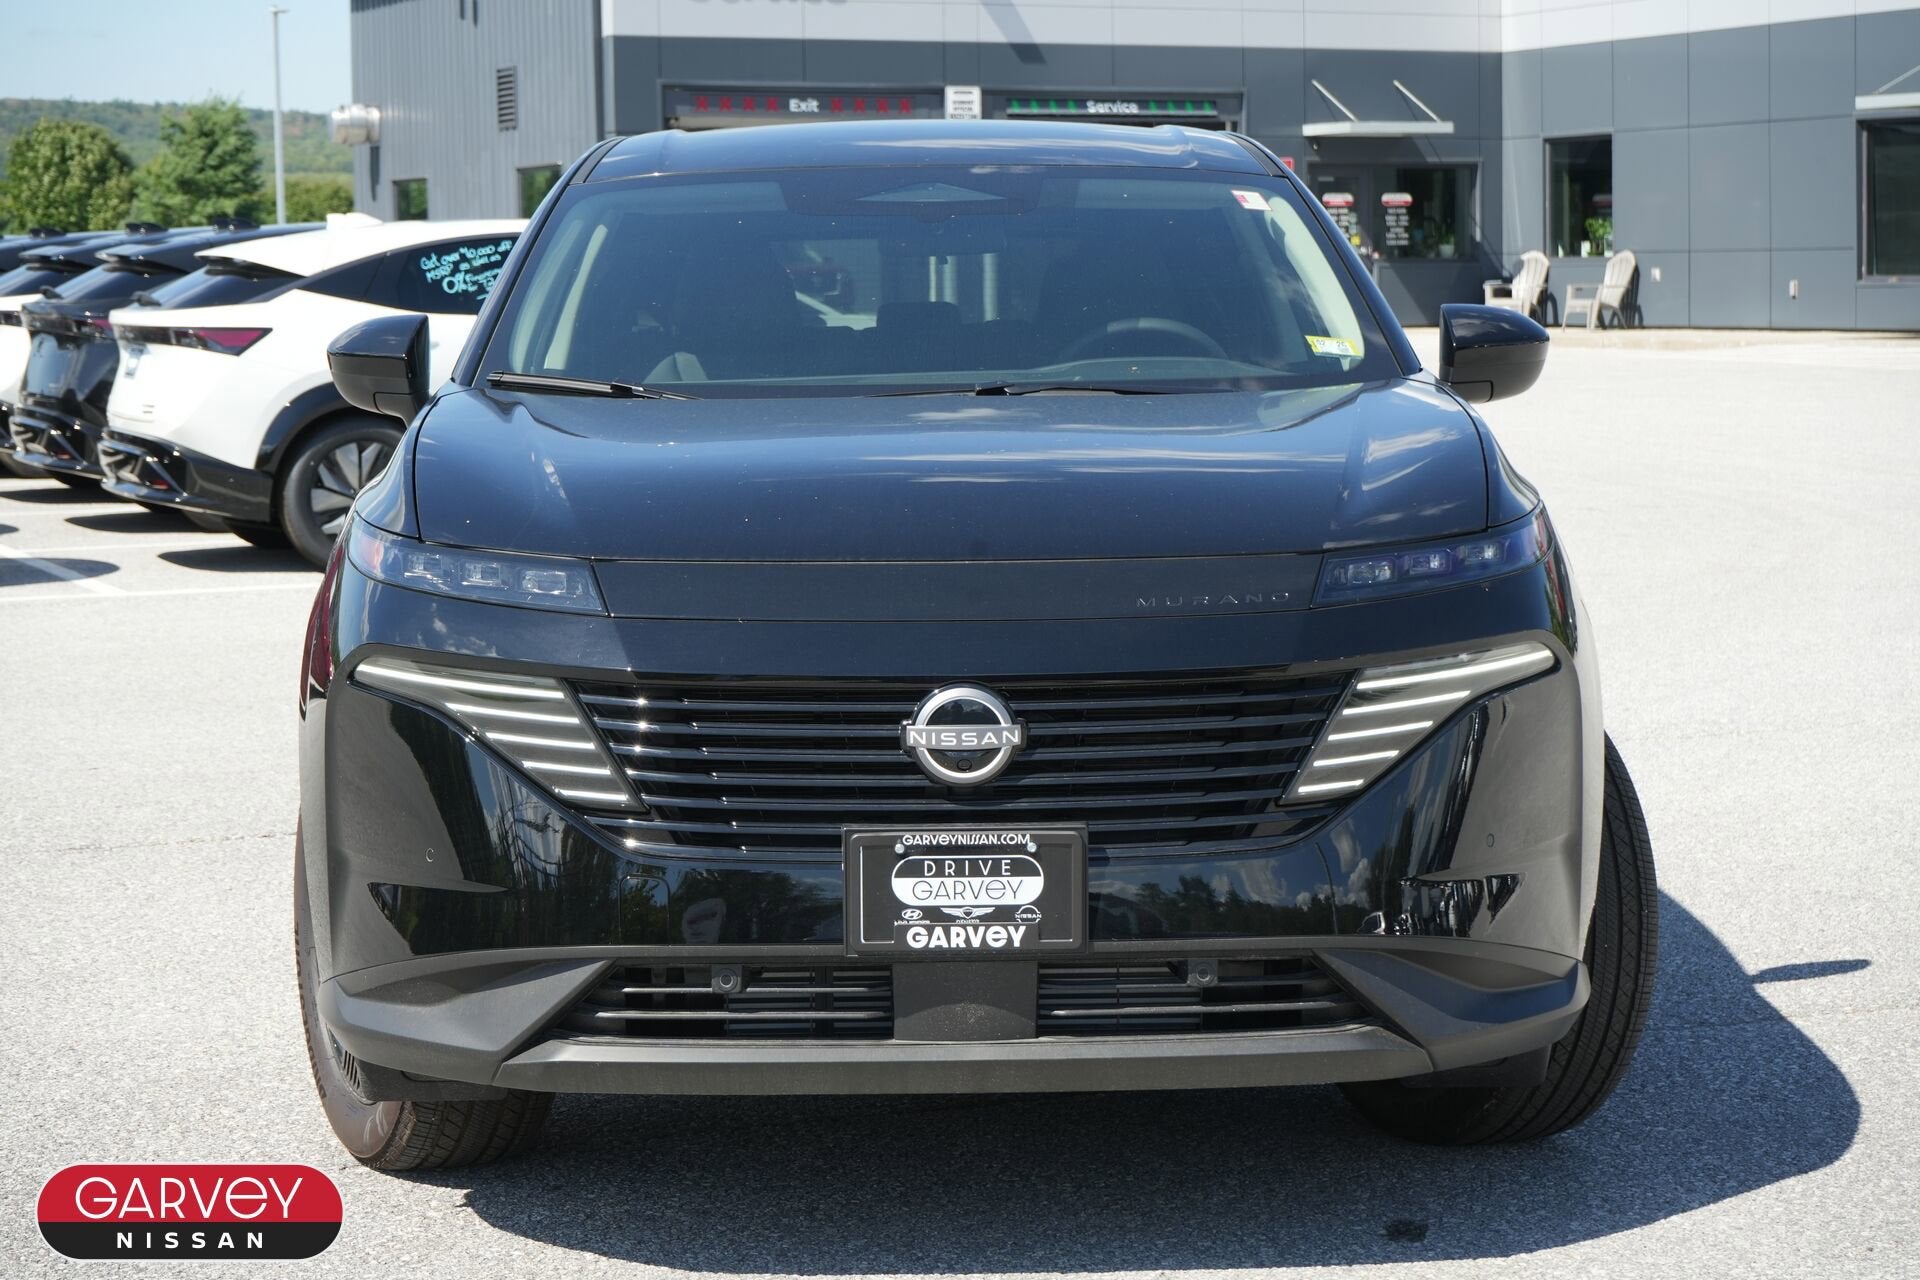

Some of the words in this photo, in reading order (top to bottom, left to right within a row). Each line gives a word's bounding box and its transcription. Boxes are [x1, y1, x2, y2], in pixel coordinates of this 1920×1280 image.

[788, 97, 820, 113] Exit
[1086, 99, 1139, 114] Service
[1136, 592, 1289, 608] MURANO
[909, 729, 1019, 746] NISSAN
[923, 859, 1012, 877] DRIVE
